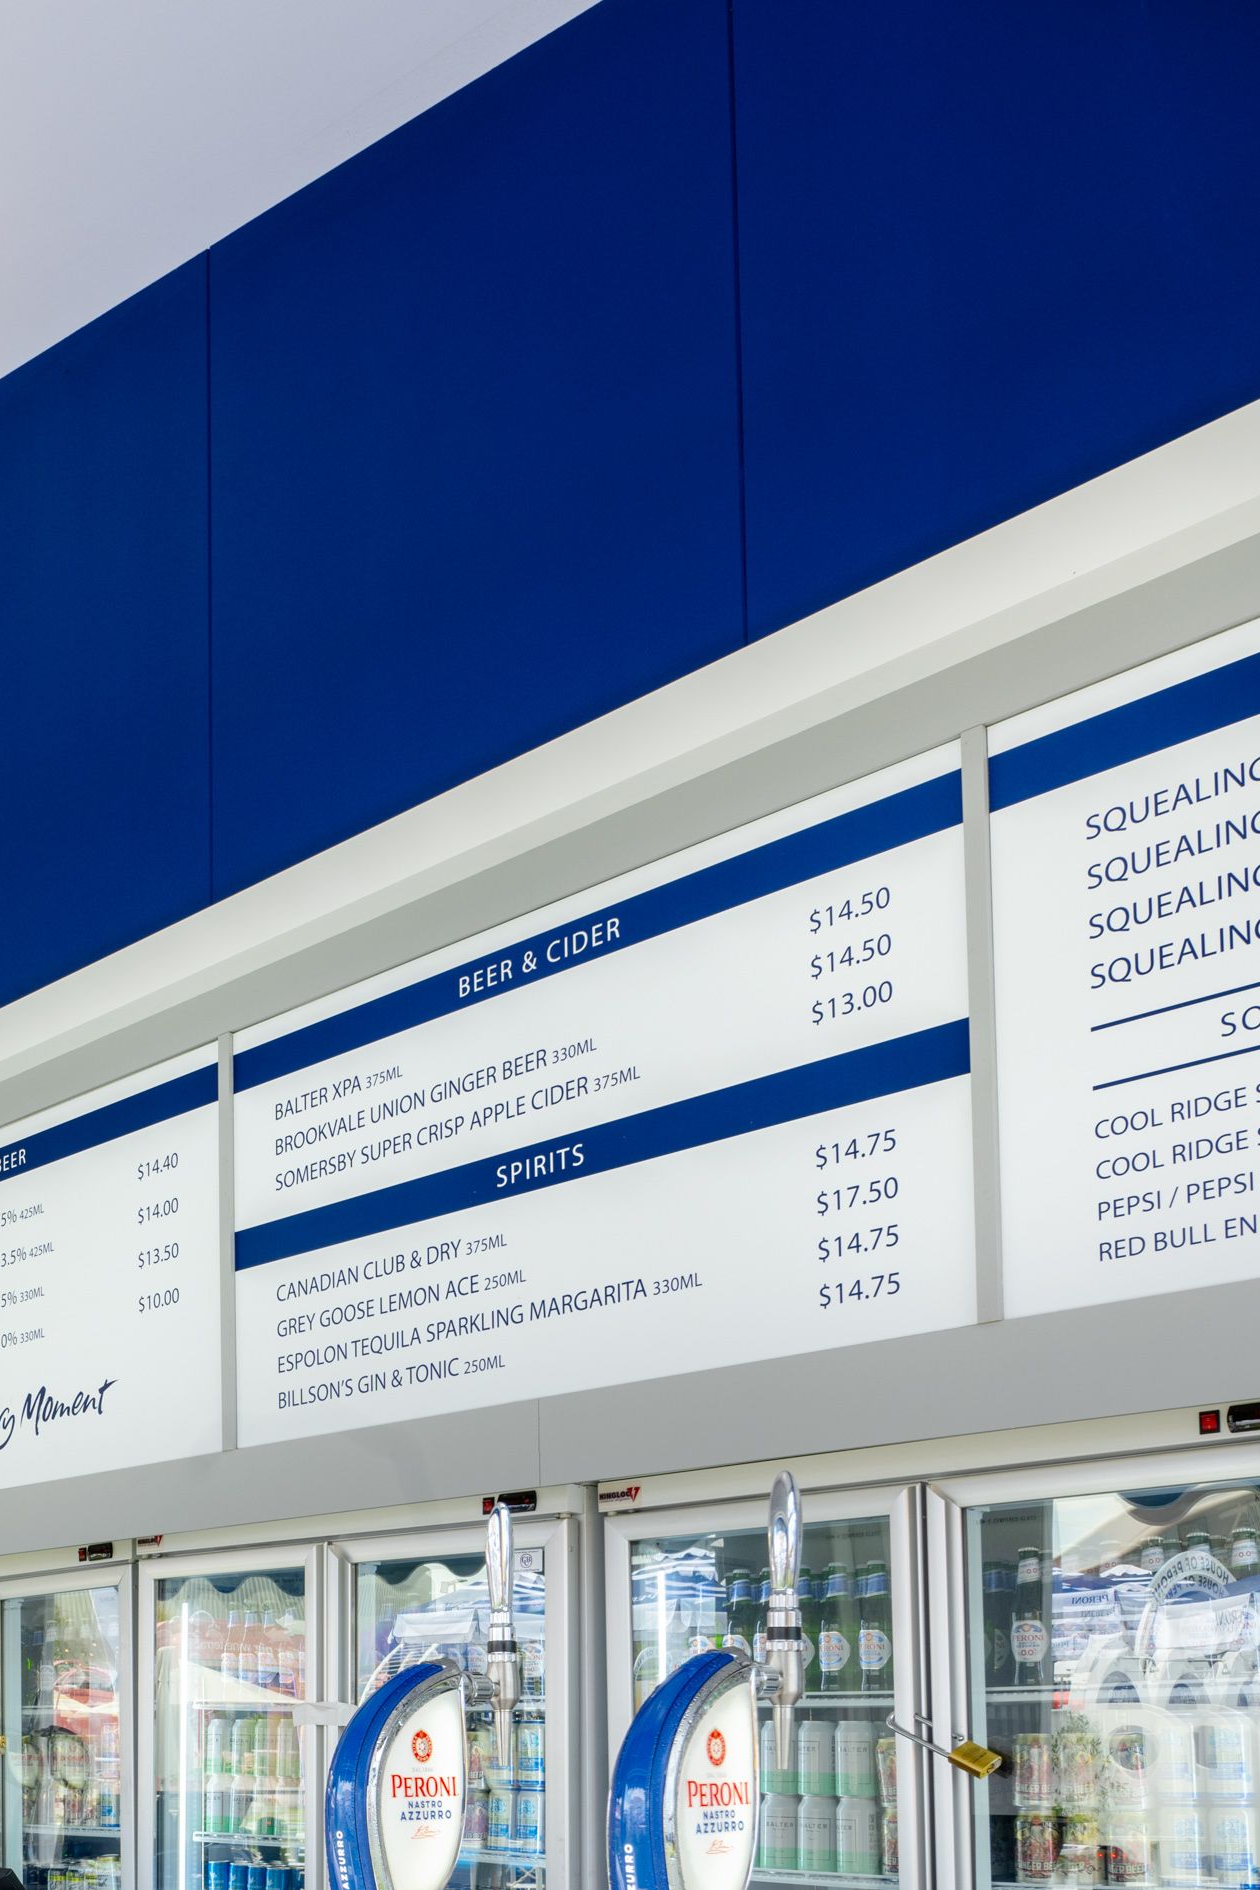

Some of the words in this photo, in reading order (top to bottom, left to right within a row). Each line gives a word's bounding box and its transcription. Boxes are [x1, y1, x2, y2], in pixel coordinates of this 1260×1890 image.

[809, 886, 891, 935] $14.50
[458, 959, 513, 998] BEER
[521, 950, 537, 974] &
[546, 917, 620, 963] CIDER
[810, 933, 892, 981] $14.50
[811, 980, 893, 1026] $13.00
[275, 1086, 329, 1121] BALTER
[332, 1075, 362, 1101] XPA
[365, 1065, 404, 1089] 375ML
[275, 1109, 366, 1156] BROOKVALE
[370, 1089, 425, 1124] UNION
[430, 1065, 497, 1104] GINGER
[502, 1048, 548, 1081] BEER
[552, 1038, 598, 1065] 330ML
[1094, 1108, 1164, 1139] COOL
[1170, 1086, 1248, 1123] RIDGE
[275, 1149, 357, 1192] SOMERSBY
[360, 1132, 413, 1165] SUPER
[416, 1115, 465, 1146] CRISP
[469, 1095, 527, 1131] APPLE
[531, 1076, 589, 1111] CIDER
[593, 1065, 641, 1093] 375ML
[137, 1152, 179, 1182] $14.40
[496, 1143, 585, 1188] SPIRITS
[815, 1128, 897, 1171] $14.75
[1095, 1149, 1165, 1180] COOL
[1172, 1129, 1249, 1165] RIDGE
[0, 1209, 18, 1228] 5%
[19, 1203, 45, 1220] 425ML
[137, 1197, 179, 1225] $14.00
[816, 1176, 899, 1217] $17.50
[1097, 1190, 1161, 1222] PEPSI
[1168, 1186, 1179, 1209] /
[1186, 1171, 1254, 1204] PEPSI
[0, 1247, 27, 1268] 3.5%
[28, 1242, 55, 1258] 425ML
[138, 1242, 180, 1270] $13.50
[818, 1223, 899, 1263] $14.75
[1099, 1236, 1146, 1262] RED
[1153, 1223, 1217, 1252] BULL
[276, 1265, 359, 1302] CANADIAN
[363, 1254, 406, 1281] CLUB
[409, 1249, 422, 1269] &
[426, 1238, 462, 1266] DRY
[465, 1233, 508, 1256] 375ML
[0, 1291, 18, 1308] 5%
[19, 1286, 45, 1303] 330ML
[138, 1287, 180, 1314] $10.00
[276, 1312, 316, 1338] GREY
[319, 1298, 375, 1328] GOOSE
[379, 1283, 440, 1315] LEMON
[445, 1273, 480, 1300] ACE
[484, 1269, 527, 1291] 250ML
[819, 1271, 901, 1310] $14.75
[0, 1331, 18, 1349] 0%
[20, 1327, 45, 1344] 330ML
[277, 1342, 348, 1374] ESPOLON
[350, 1327, 422, 1358] TEQUILA
[426, 1304, 524, 1343] SPARKLING
[529, 1278, 648, 1322] MARGARITA
[653, 1272, 703, 1296] 330ML
[278, 1378, 354, 1410] BILLSON'S
[357, 1371, 386, 1394] GIN
[390, 1368, 403, 1388] &
[405, 1357, 460, 1385] TONIC
[463, 1354, 506, 1375] 250ML
[20, 1378, 118, 1436] Moment
[1012, 1633, 1045, 1642] PERONI
[391, 1775, 457, 1798] PERONI
[408, 1800, 443, 1809] NASTRO
[687, 1781, 749, 1808] PERONI
[400, 1810, 452, 1821] AZZURRO
[696, 1821, 745, 1834] AZZURRO
[703, 1810, 736, 1820] NASTRO
[336, 1830, 351, 1890] AZZURRO
